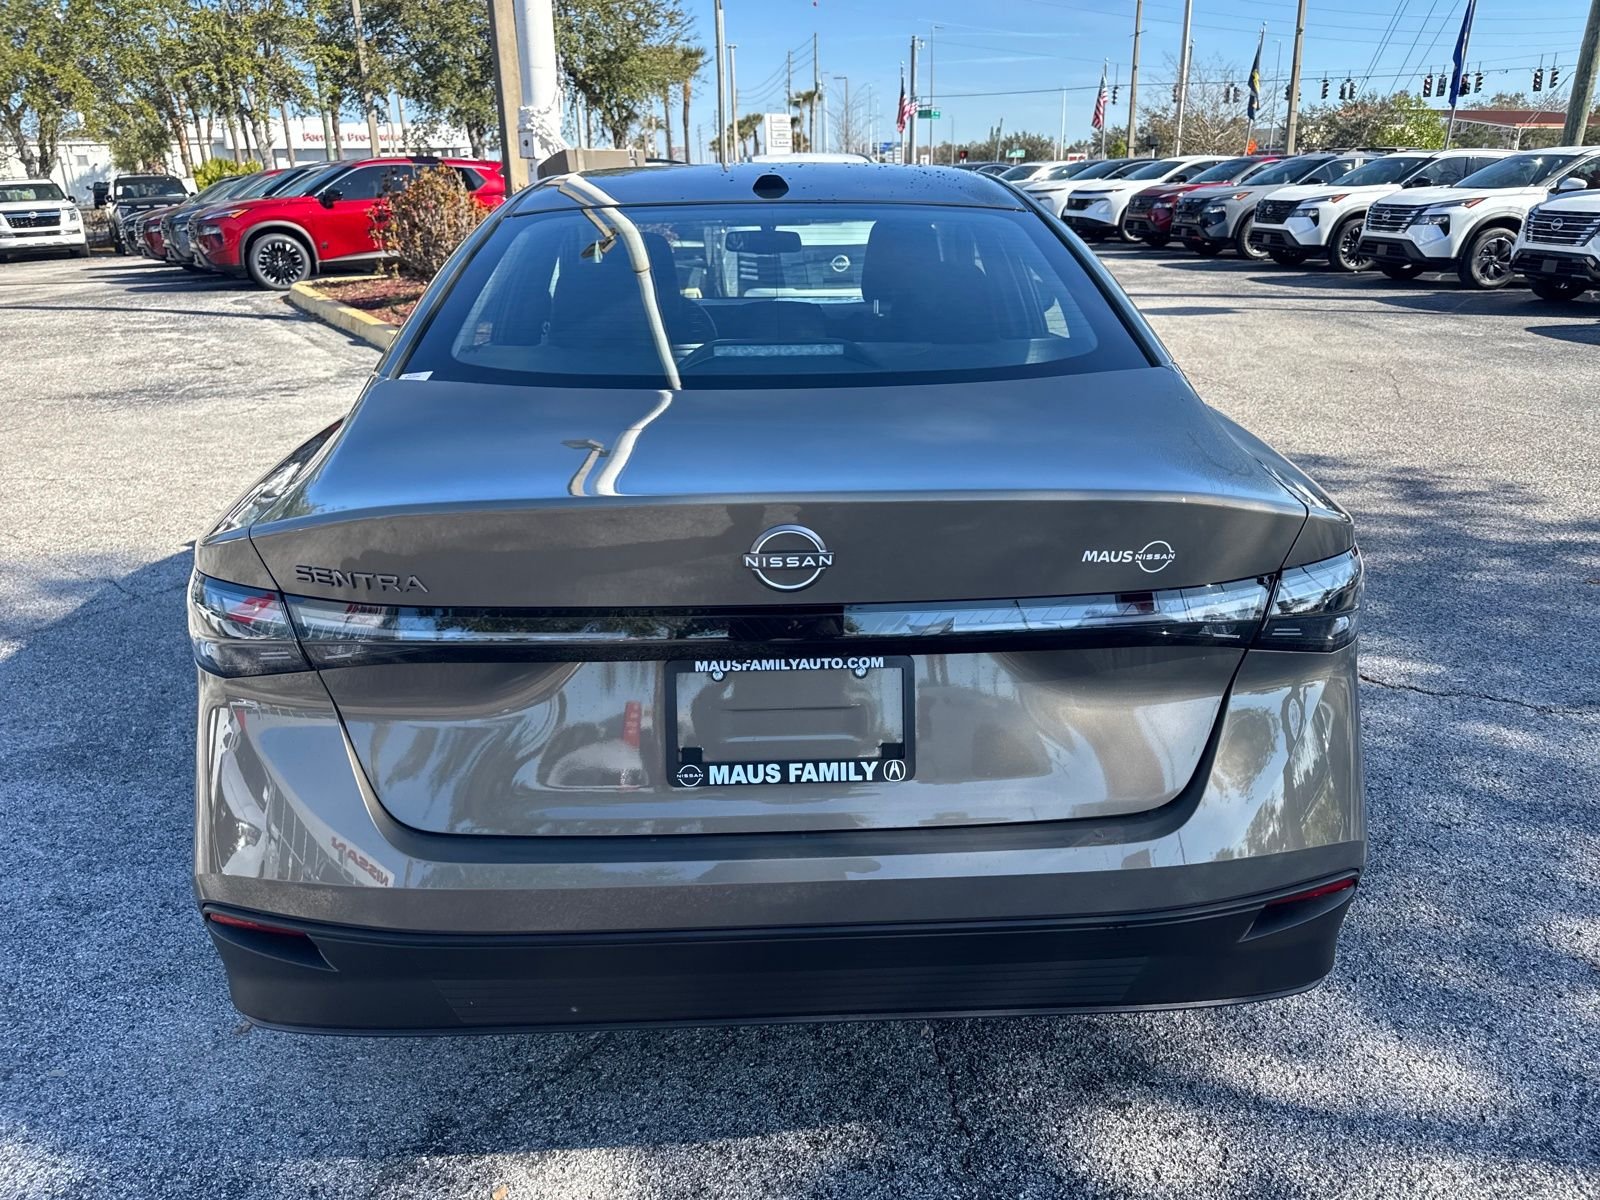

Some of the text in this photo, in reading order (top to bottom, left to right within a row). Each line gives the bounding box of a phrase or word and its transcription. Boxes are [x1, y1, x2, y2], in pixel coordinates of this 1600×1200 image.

[745, 555, 832, 568] NISSAN
[1082, 550, 1176, 563] MAUS NISSAN
[295, 565, 429, 593] SENTRA
[694, 656, 884, 672] MAUSFAMILYAUTO.COM
[709, 761, 879, 785] MAUS FAMILY
